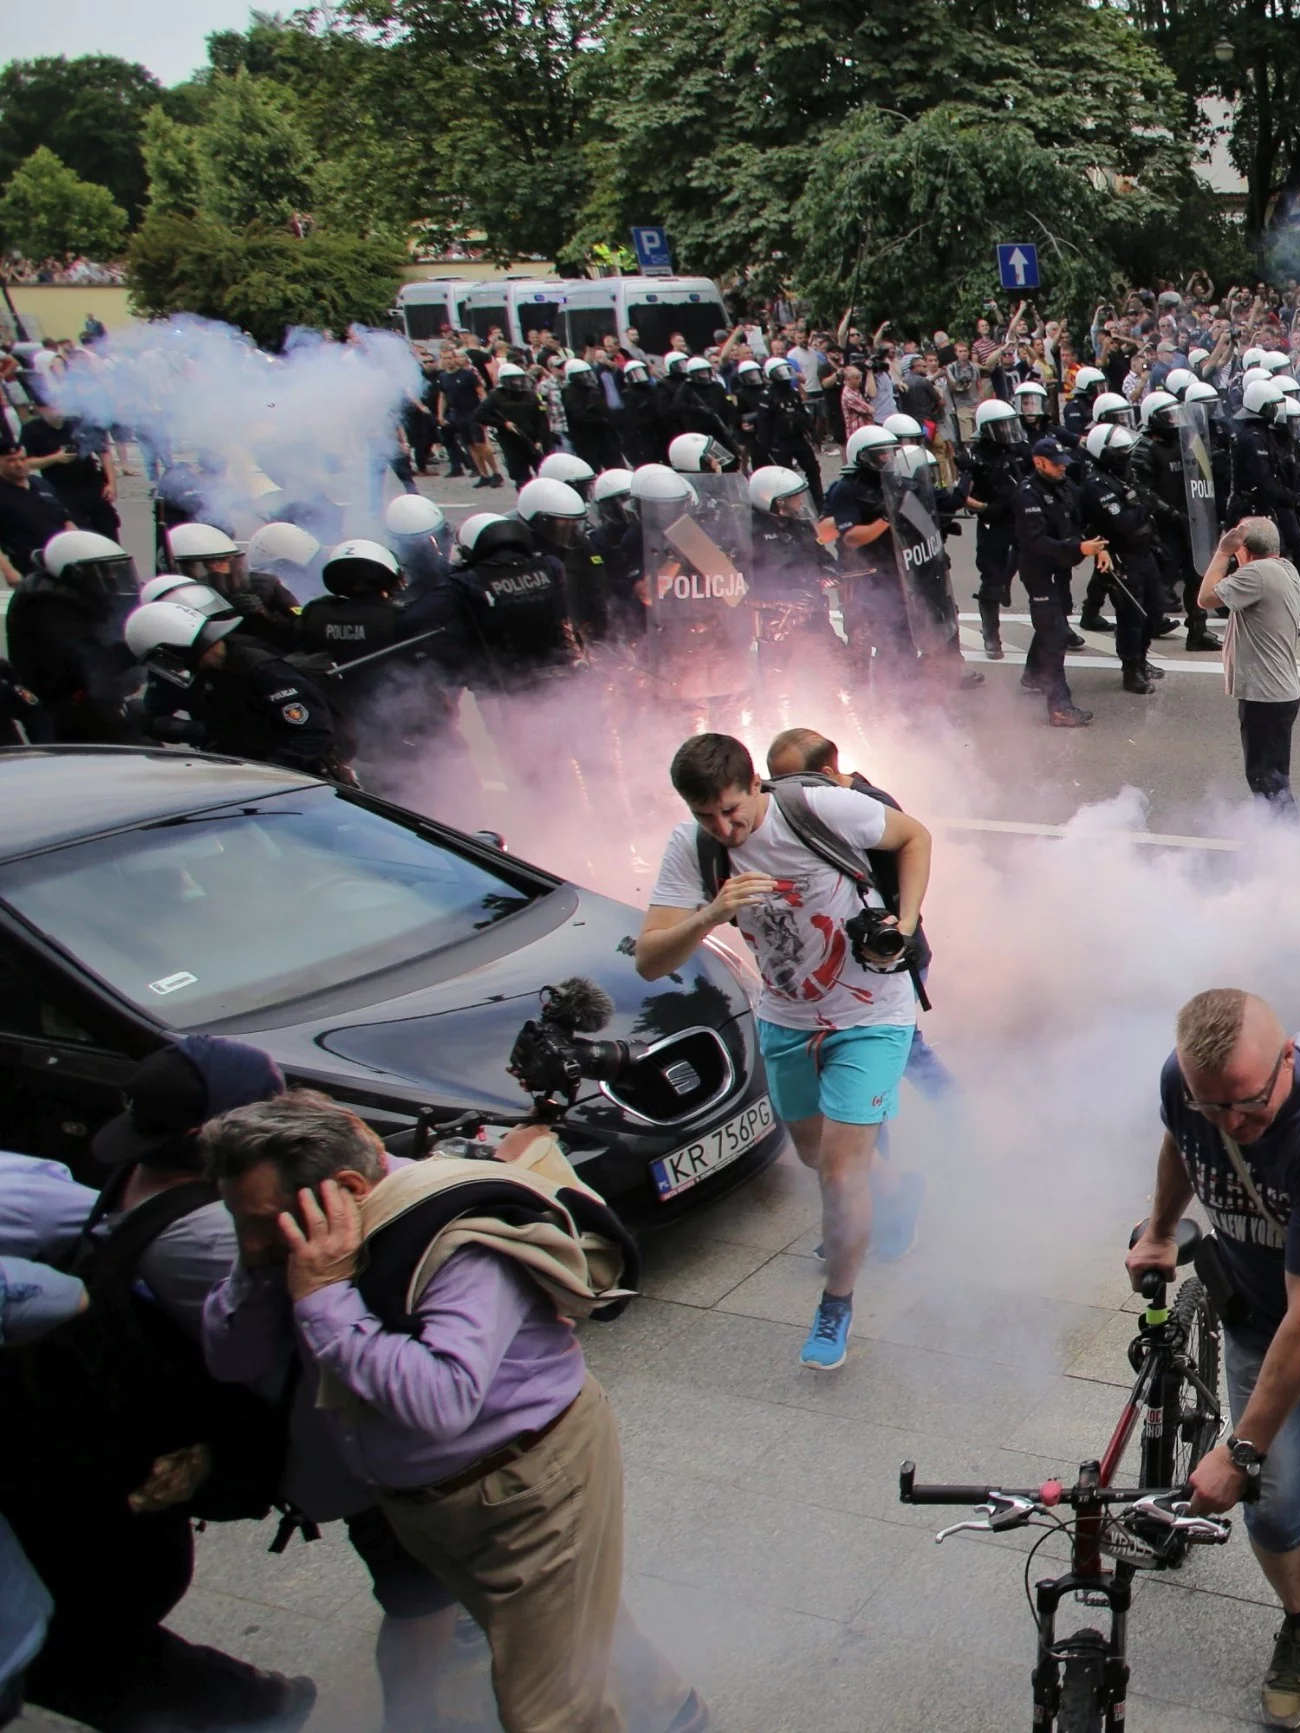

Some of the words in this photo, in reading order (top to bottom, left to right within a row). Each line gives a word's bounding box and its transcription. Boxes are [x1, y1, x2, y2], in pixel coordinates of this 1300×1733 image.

[640, 230, 661, 256] P
[491, 571, 551, 595] POLICJA
[658, 572, 748, 600] POLICJA
[326, 624, 366, 640] POLICJA
[270, 687, 298, 702] POLICJA
[669, 1143, 709, 1184] KR
[711, 1101, 771, 1159] 756PG
